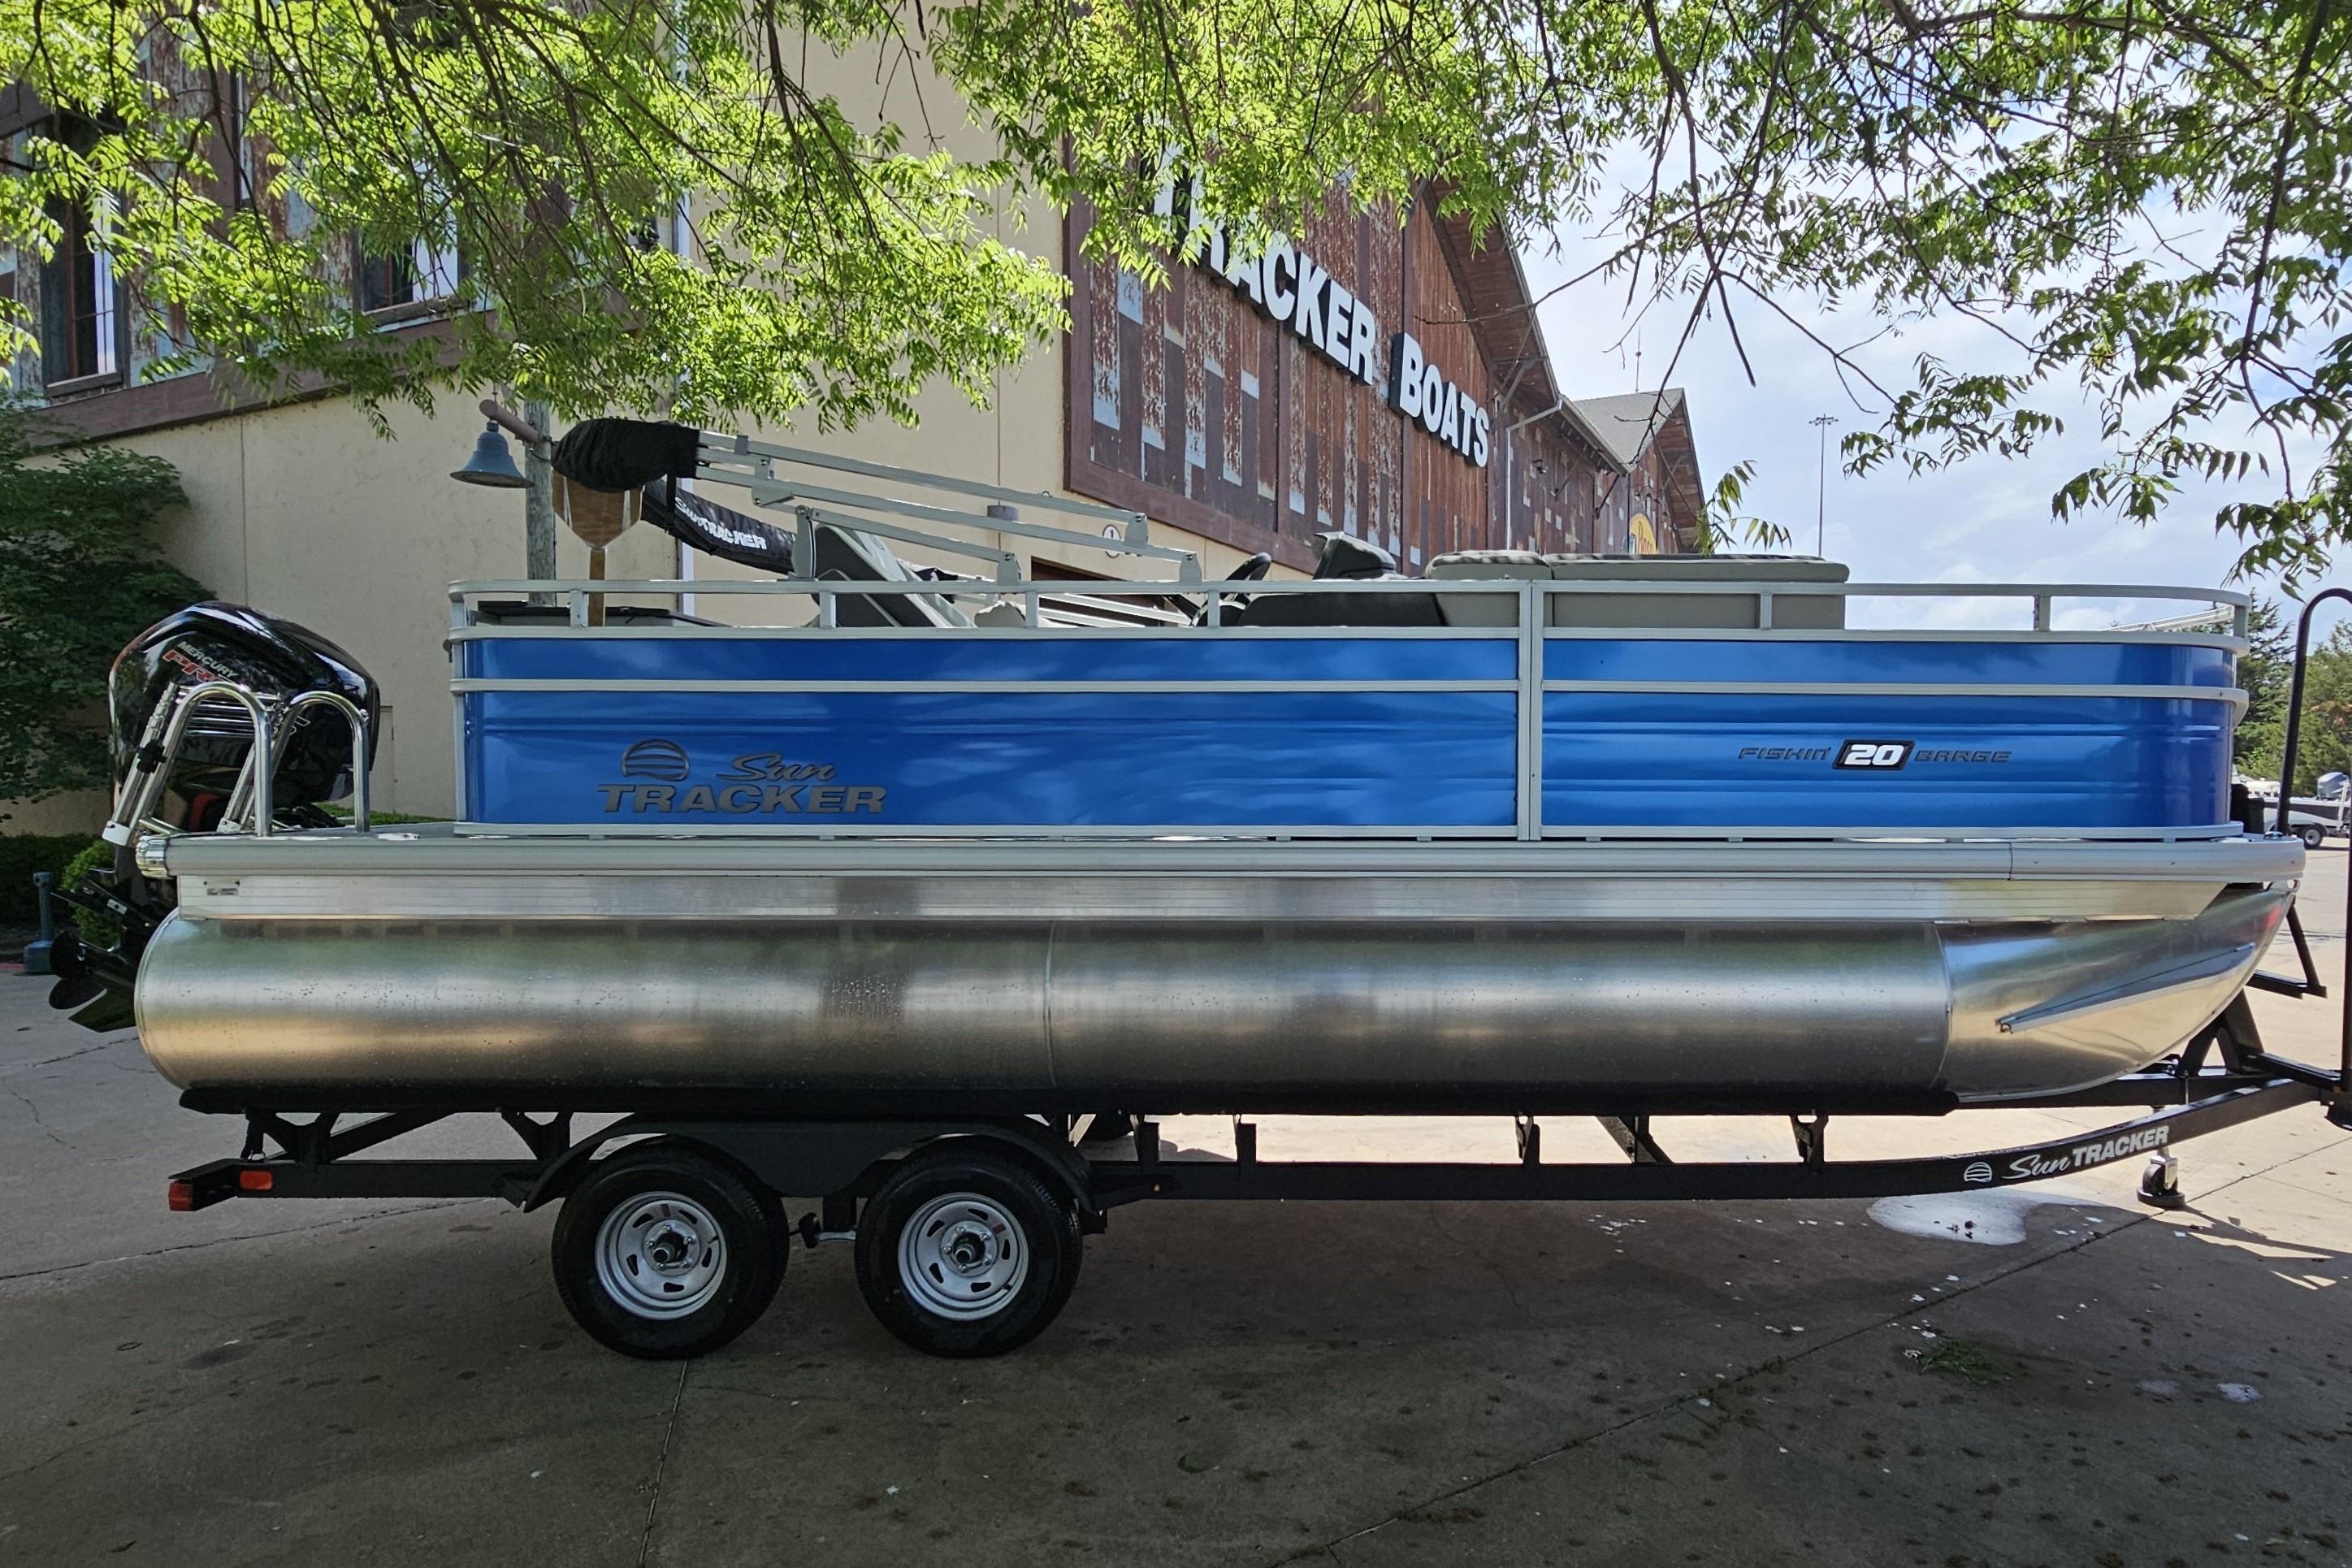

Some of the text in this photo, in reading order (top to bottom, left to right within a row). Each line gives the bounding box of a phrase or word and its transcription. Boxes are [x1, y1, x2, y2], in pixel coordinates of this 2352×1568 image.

[1400, 332, 1489, 467] BOATS
[698, 518, 767, 550] TRACKER
[177, 641, 239, 678] MERCURY
[716, 752, 838, 782] Sun
[1843, 744, 1904, 765] 20
[1914, 750, 2012, 763] BARGE
[597, 784, 887, 813] TRACKER
[2001, 1126, 2169, 1180] Sun TRACKER
